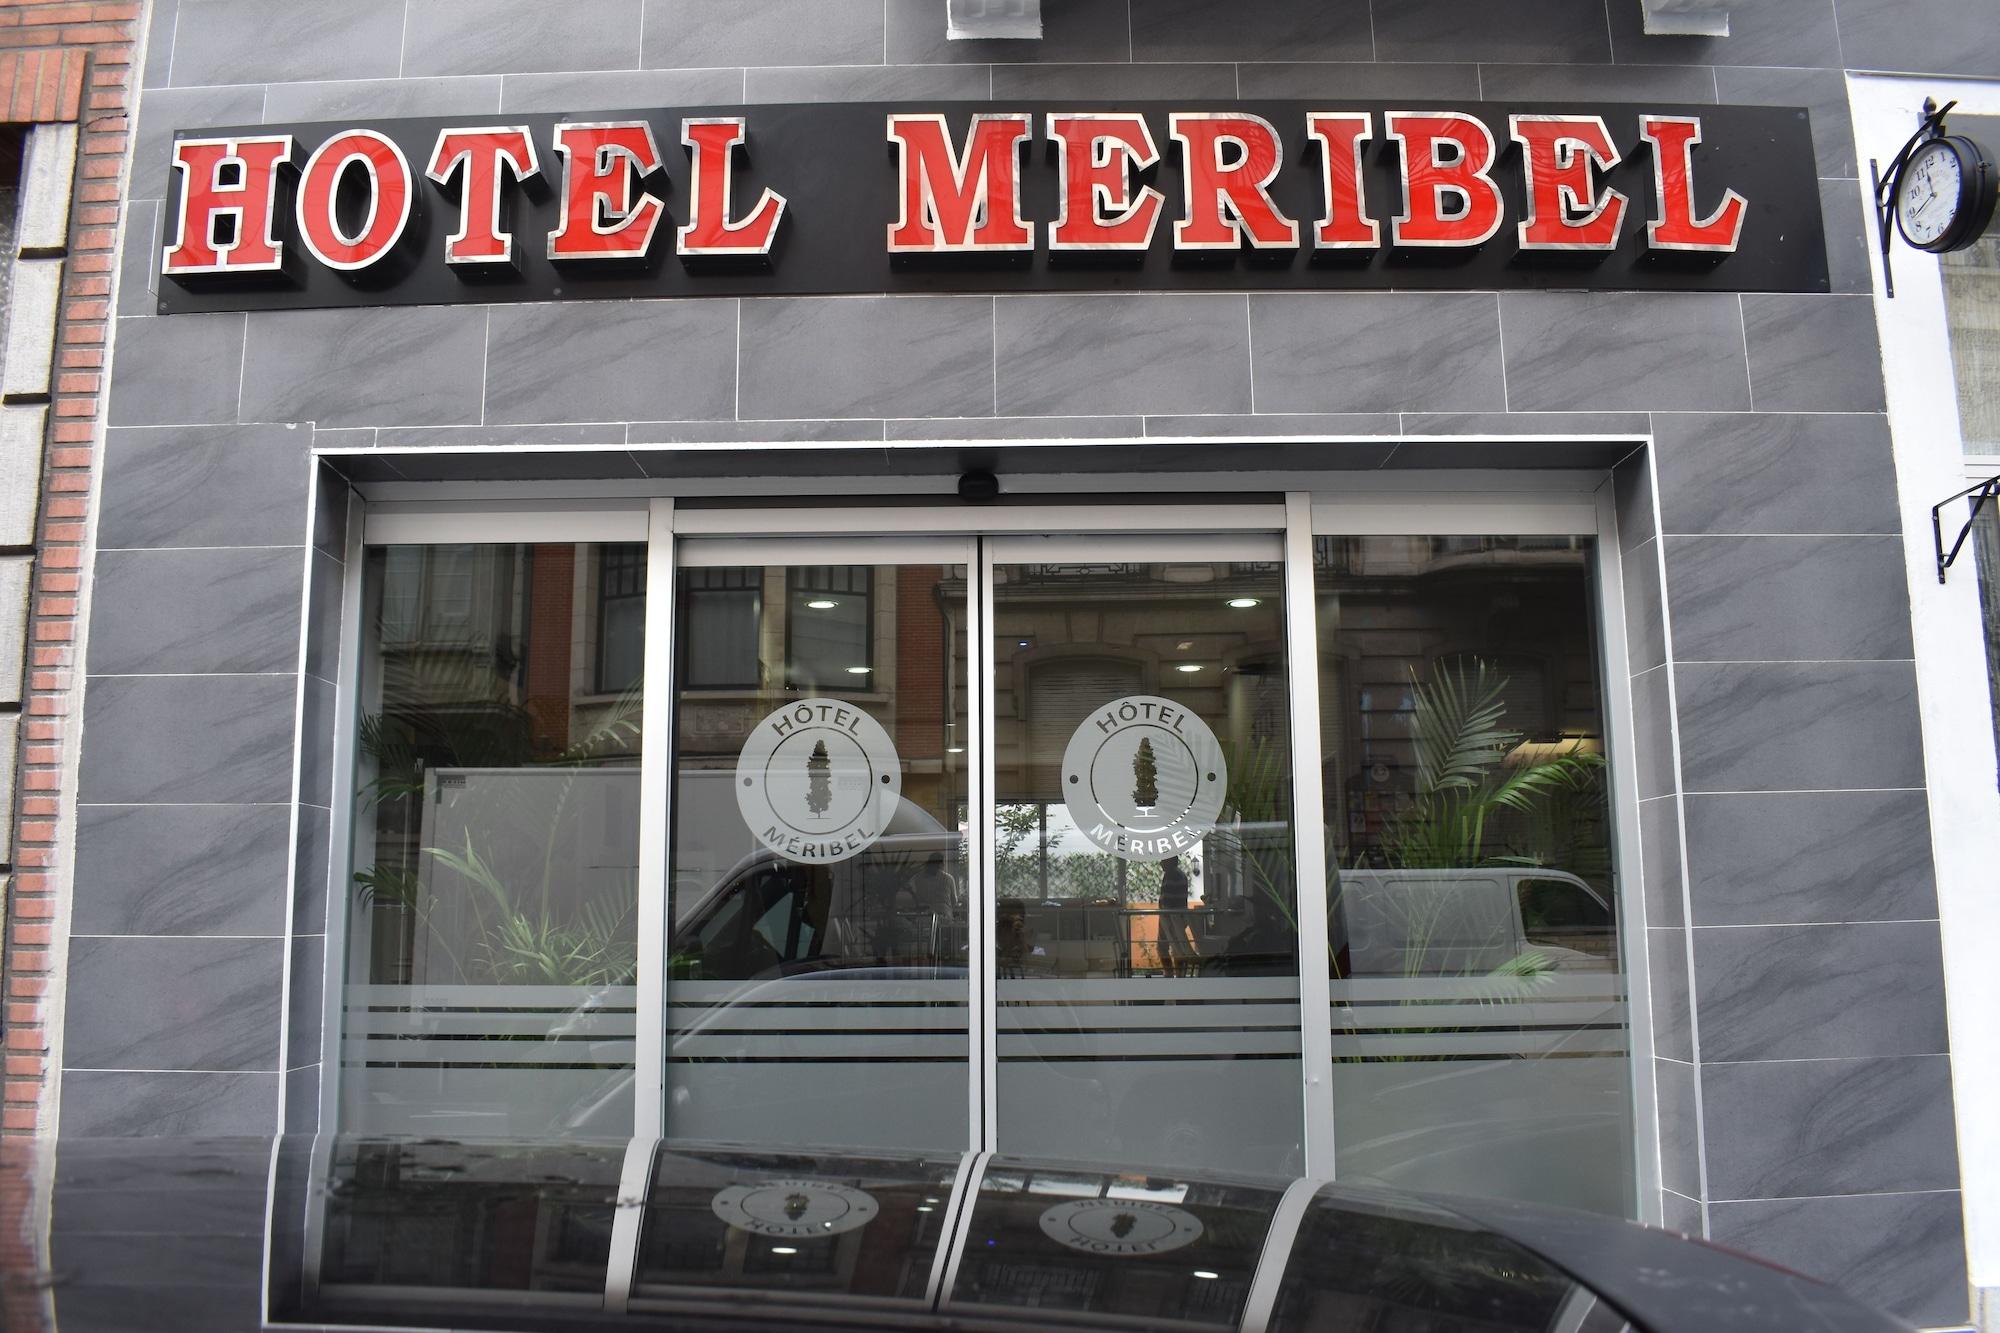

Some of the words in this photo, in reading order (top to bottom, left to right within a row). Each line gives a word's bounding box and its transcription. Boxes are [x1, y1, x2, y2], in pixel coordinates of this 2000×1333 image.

[1924, 155, 1935, 169] 12
[1916, 168, 1925, 181] 11
[161, 117, 787, 275] HOTEL
[886, 111, 1748, 252] MERIBEL
[1910, 185, 1920, 200] 10
[1915, 220, 1921, 233] 8
[1925, 226, 1931, 238] 7
[1937, 222, 1944, 235] 6
[771, 704, 861, 737] HÔTEL
[1095, 701, 1186, 735] HÔTEL
[763, 825, 875, 858] MÉRIBEL
[1090, 823, 1202, 856] MÉRIBEL
